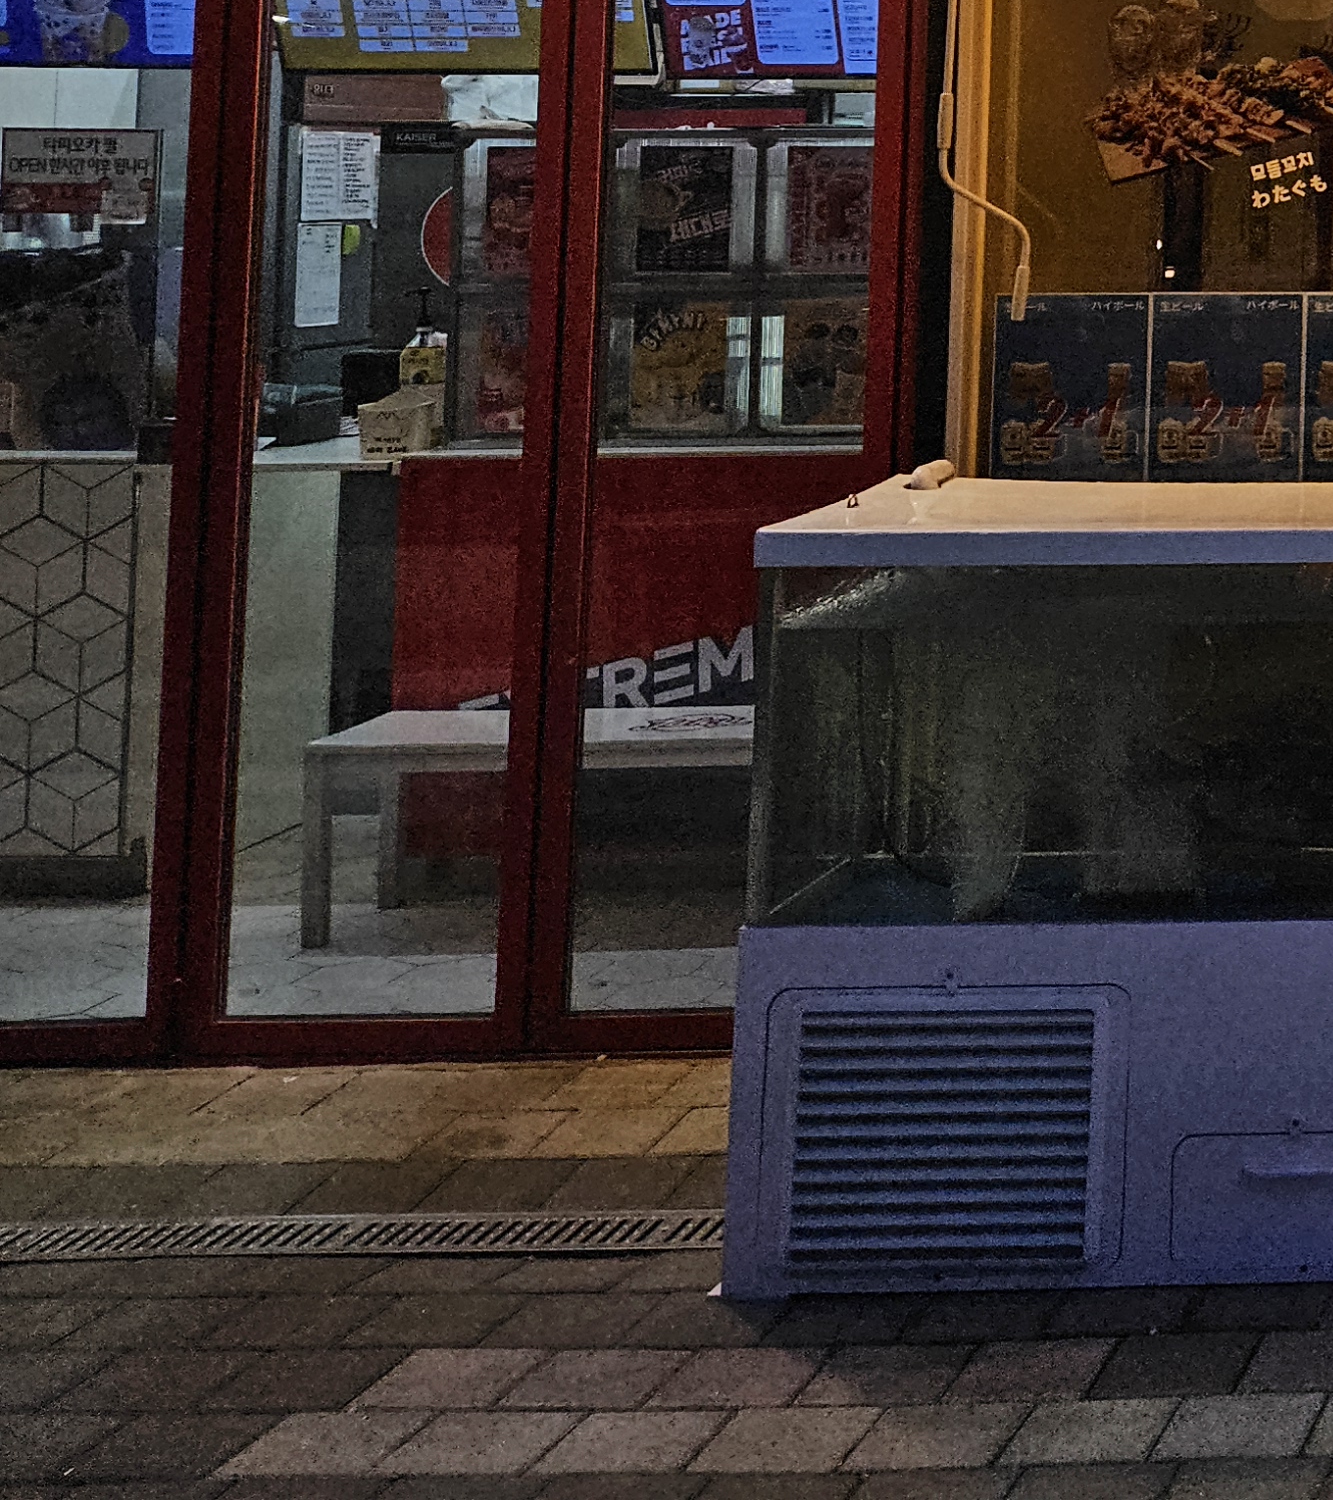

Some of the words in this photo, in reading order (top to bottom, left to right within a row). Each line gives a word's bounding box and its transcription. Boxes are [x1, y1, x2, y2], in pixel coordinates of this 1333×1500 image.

[8, 157, 47, 174] OPEN
[1249, 151, 1315, 182] 모듬꼬치
[1251, 174, 1328, 209] わたぐも
